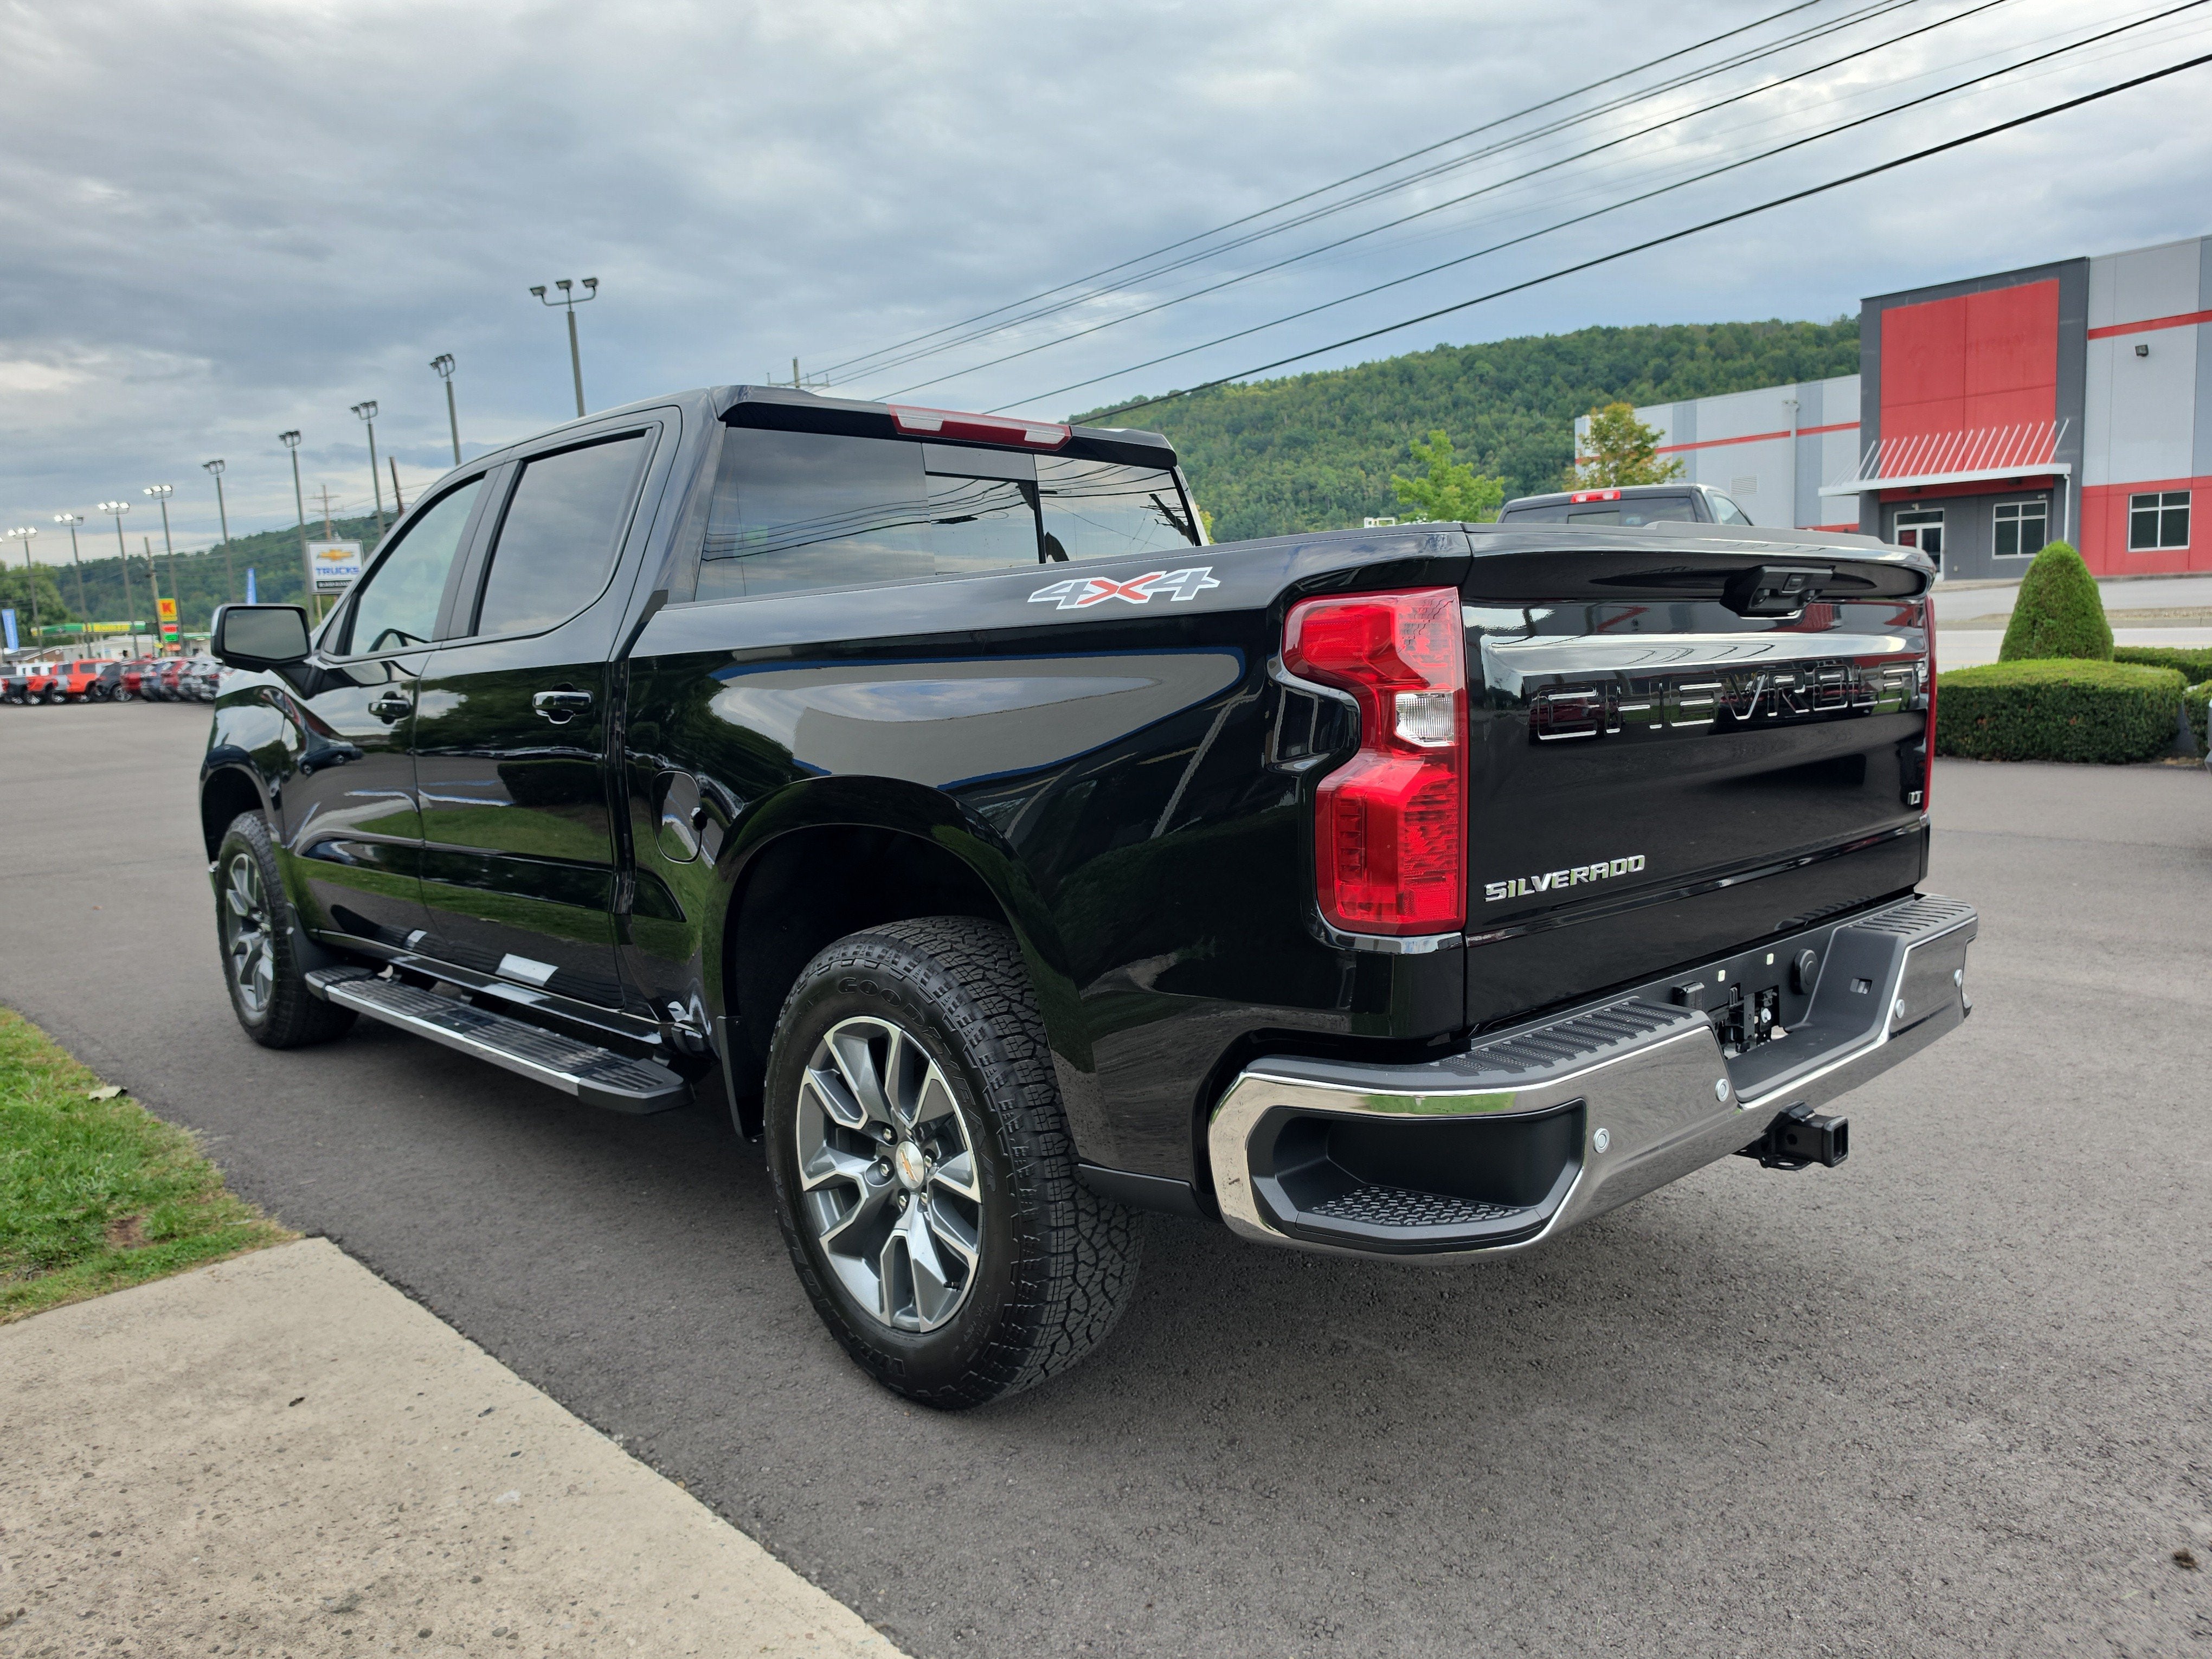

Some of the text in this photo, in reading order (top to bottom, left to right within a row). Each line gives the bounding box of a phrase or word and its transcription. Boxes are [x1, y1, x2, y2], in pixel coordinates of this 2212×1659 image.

[1537, 659, 1928, 741] CHEVROLET
[1908, 790, 1922, 805] LT
[1484, 854, 1645, 902] SILVERADO
